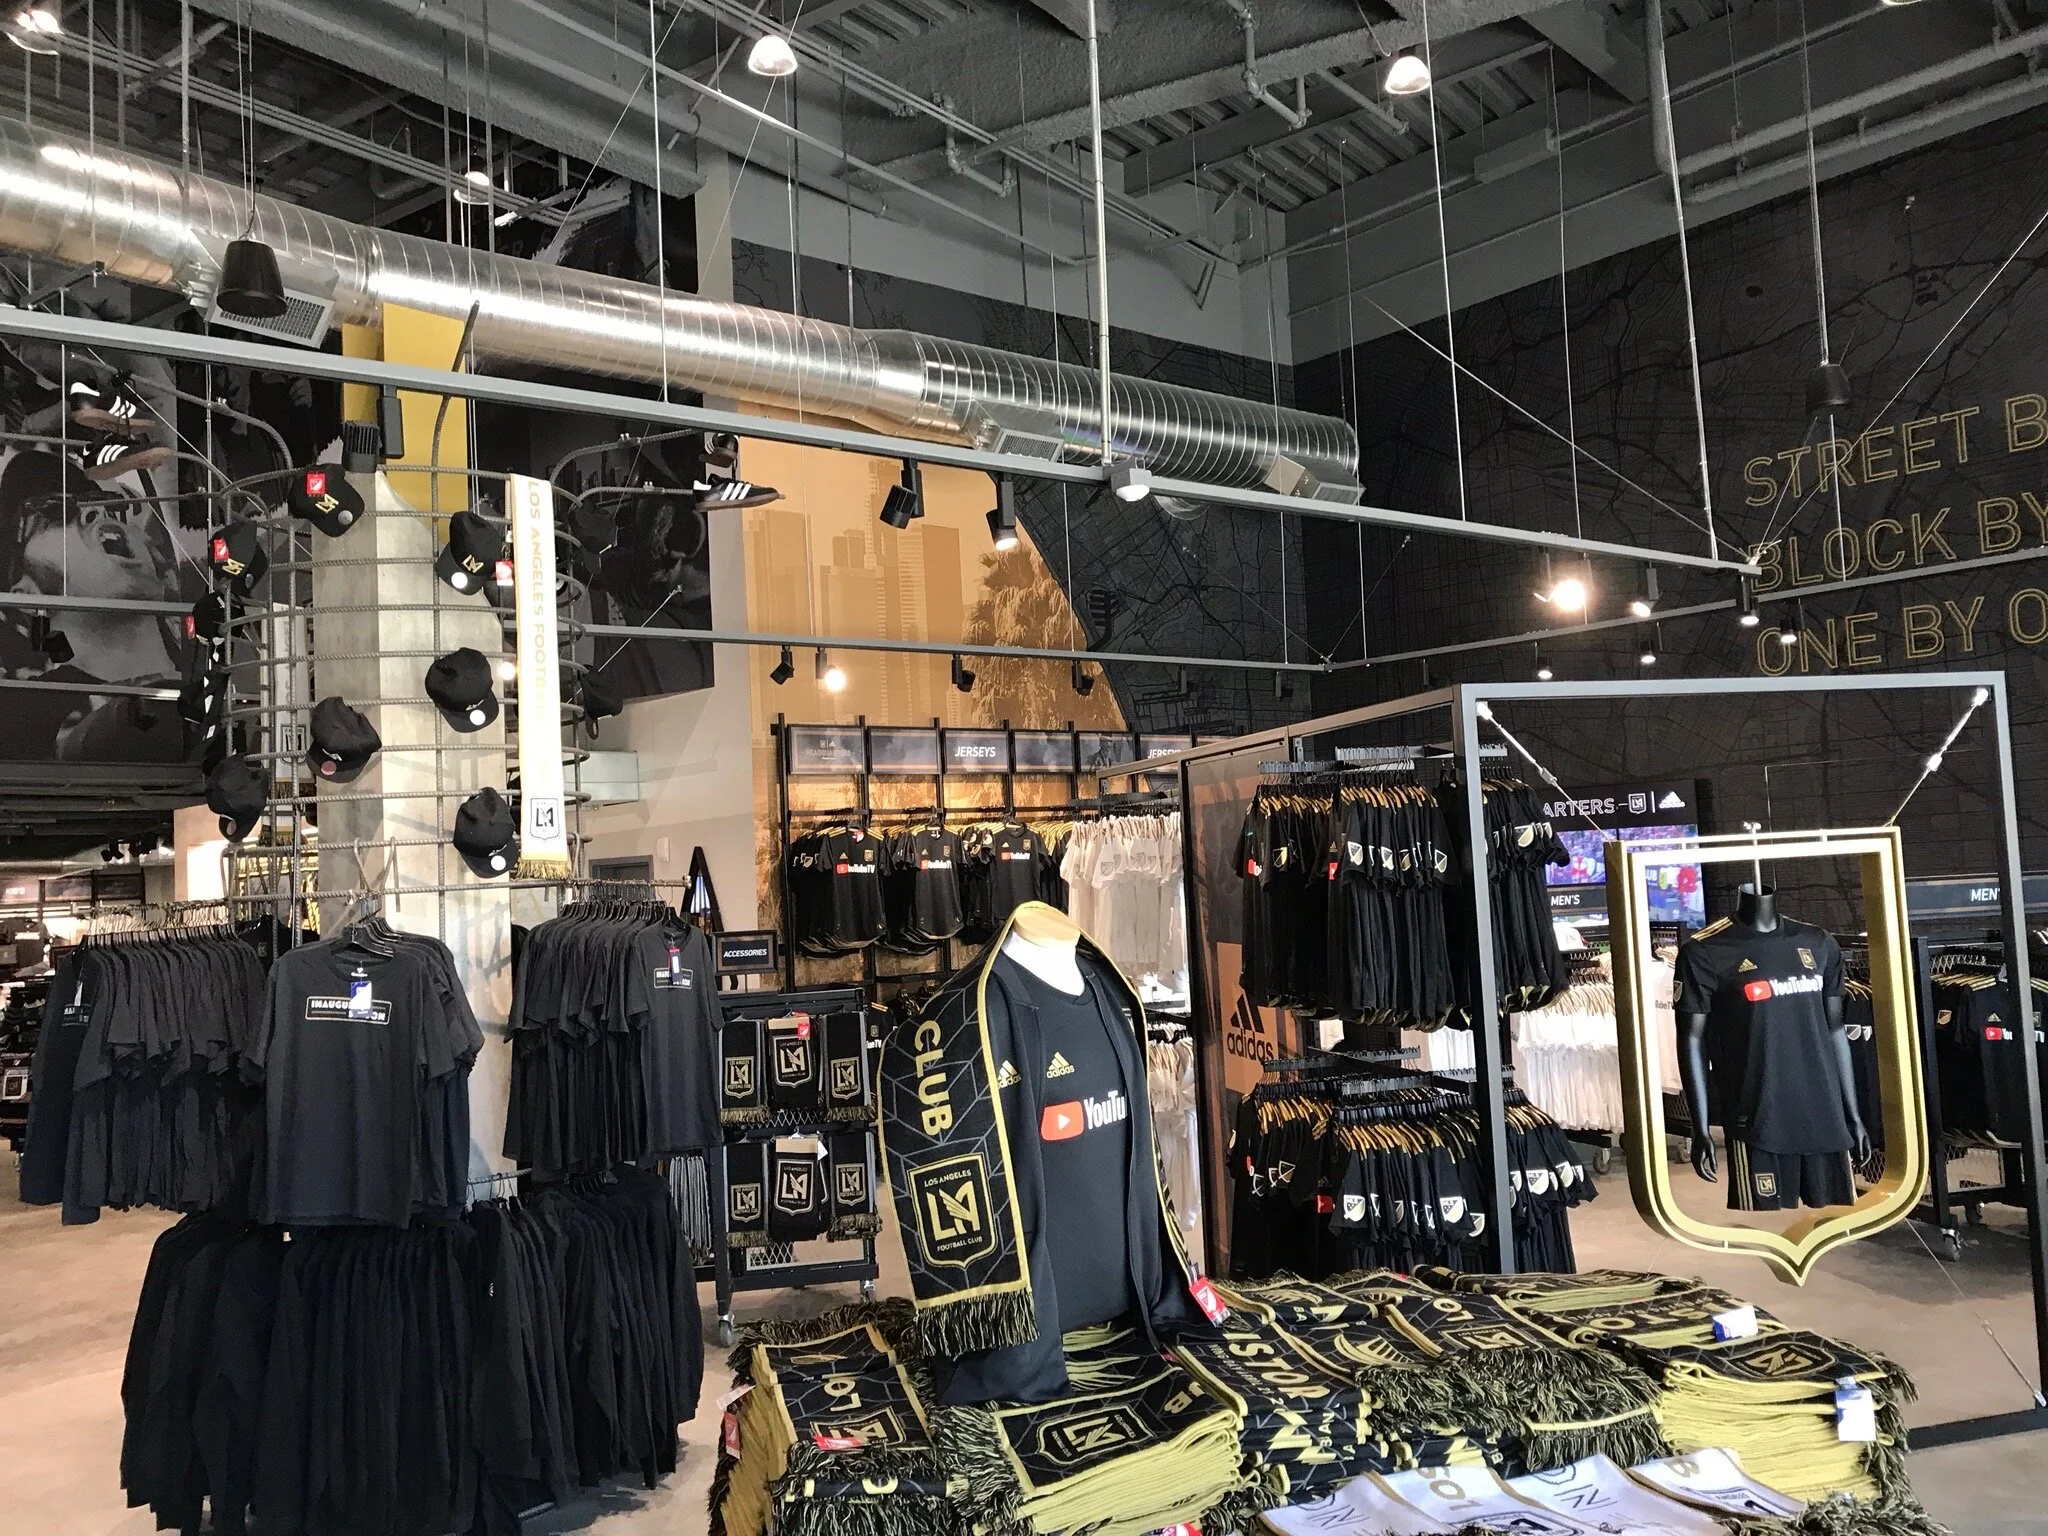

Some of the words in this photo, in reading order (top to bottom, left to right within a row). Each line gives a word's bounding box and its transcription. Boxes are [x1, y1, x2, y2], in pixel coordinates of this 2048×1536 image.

[1744, 406, 1980, 506] STREET
[528, 481, 541, 519] LOS
[1748, 507, 1957, 593] BLOCK
[530, 527, 544, 616] ANGELES
[1756, 612, 1882, 676] ONE
[1903, 596, 1985, 659] BY
[954, 746, 996, 758] JERSEYS
[1147, 748, 1182, 759] JERSE
[1550, 894, 1581, 907] MEN'S
[723, 948, 768, 958] ACCESSORIES
[1769, 974, 1824, 997] YouTubeT
[311, 999, 350, 1009] INAUGU
[1227, 1028, 1275, 1066] adidas
[914, 1020, 953, 1136] CLUB
[1047, 1064, 1075, 1079] adidas
[924, 1178, 939, 1188] LOS
[939, 1169, 972, 1184] ANGELES
[937, 1240, 968, 1252] FOOTBALL
[967, 1236, 983, 1245] CLUB
